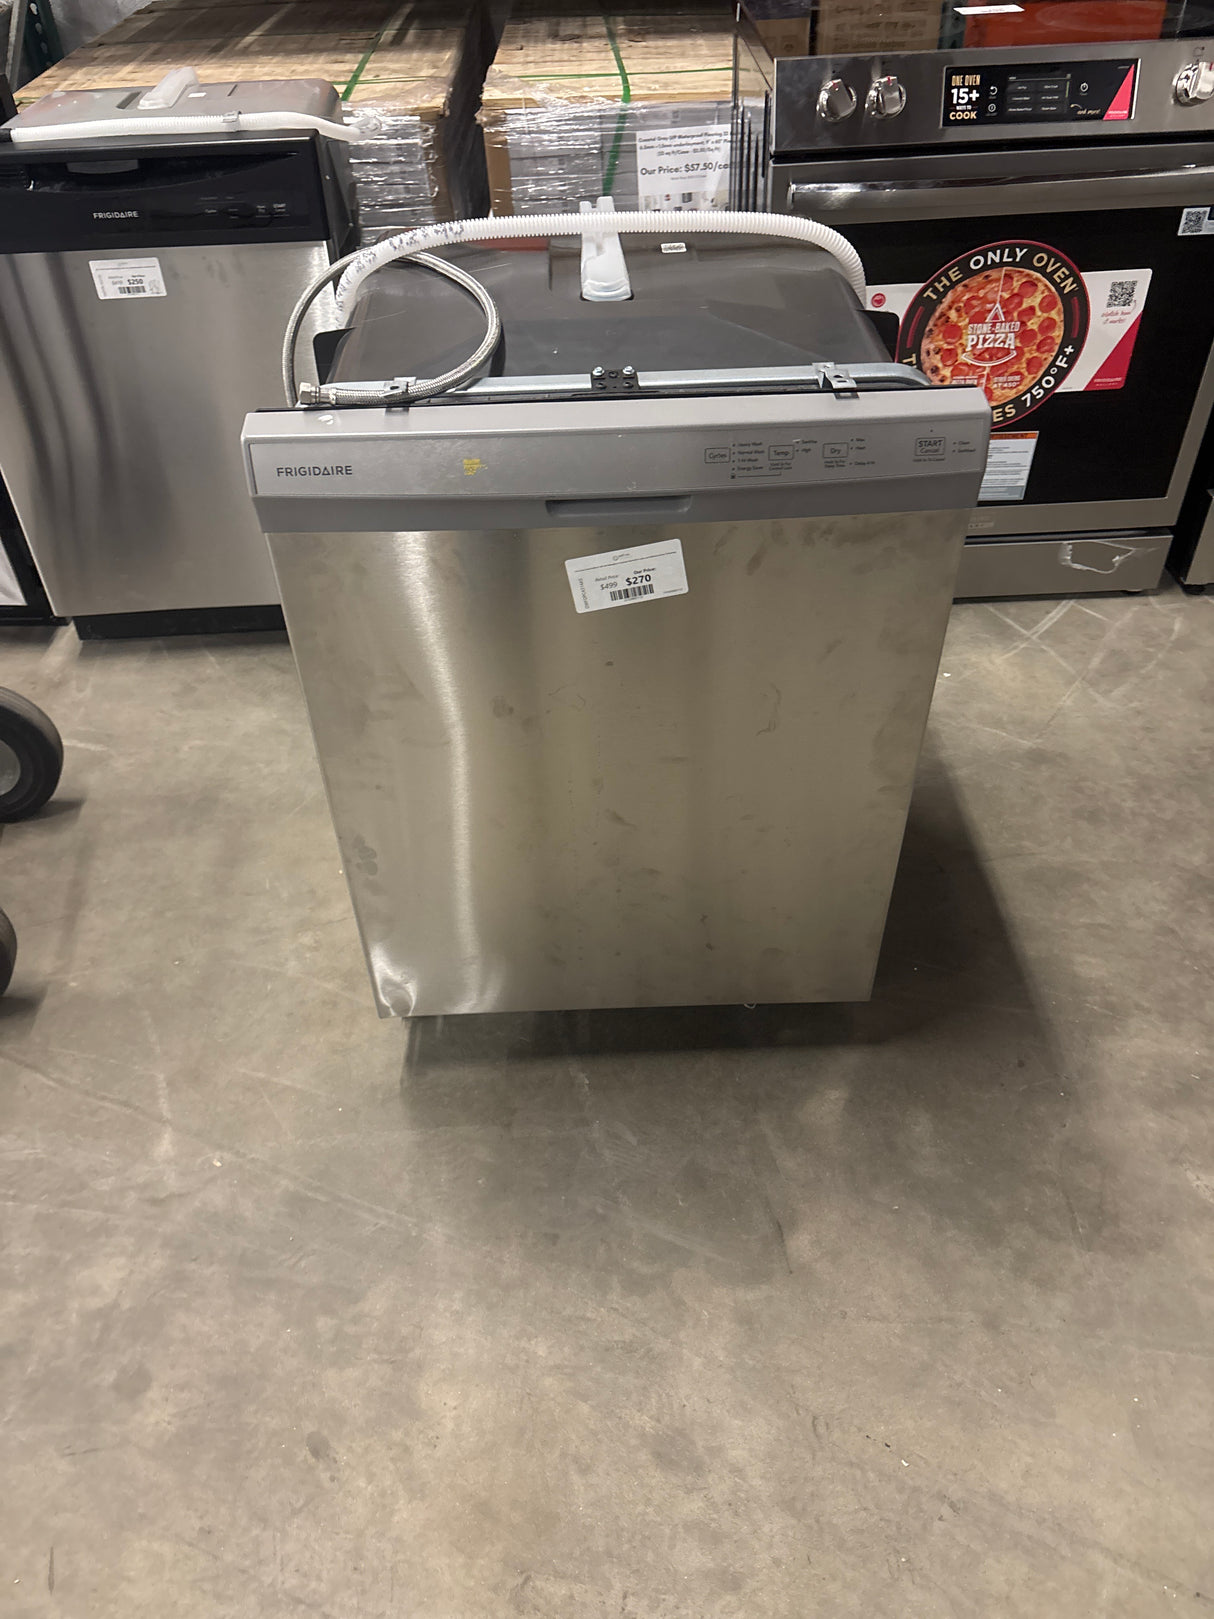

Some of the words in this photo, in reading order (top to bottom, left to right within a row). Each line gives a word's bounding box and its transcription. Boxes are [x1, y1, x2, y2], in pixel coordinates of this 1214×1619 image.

[952, 75, 964, 86] ONE
[964, 74, 980, 86] OVEN
[951, 88, 980, 104] 15+
[950, 110, 978, 120] COOK
[658, 166, 682, 174] Price:
[93, 210, 140, 219] FRIGIDAIRE
[923, 266, 964, 302] THE
[969, 248, 1028, 270] ONLY
[968, 321, 1020, 334] STONE-BAKED
[966, 333, 1016, 352] PIZZA
[1020, 344, 1074, 408] 750°F+
[276, 465, 353, 477] FRIGIDAIRE
[600, 582, 618, 590] $499
[625, 574, 652, 586] $270
